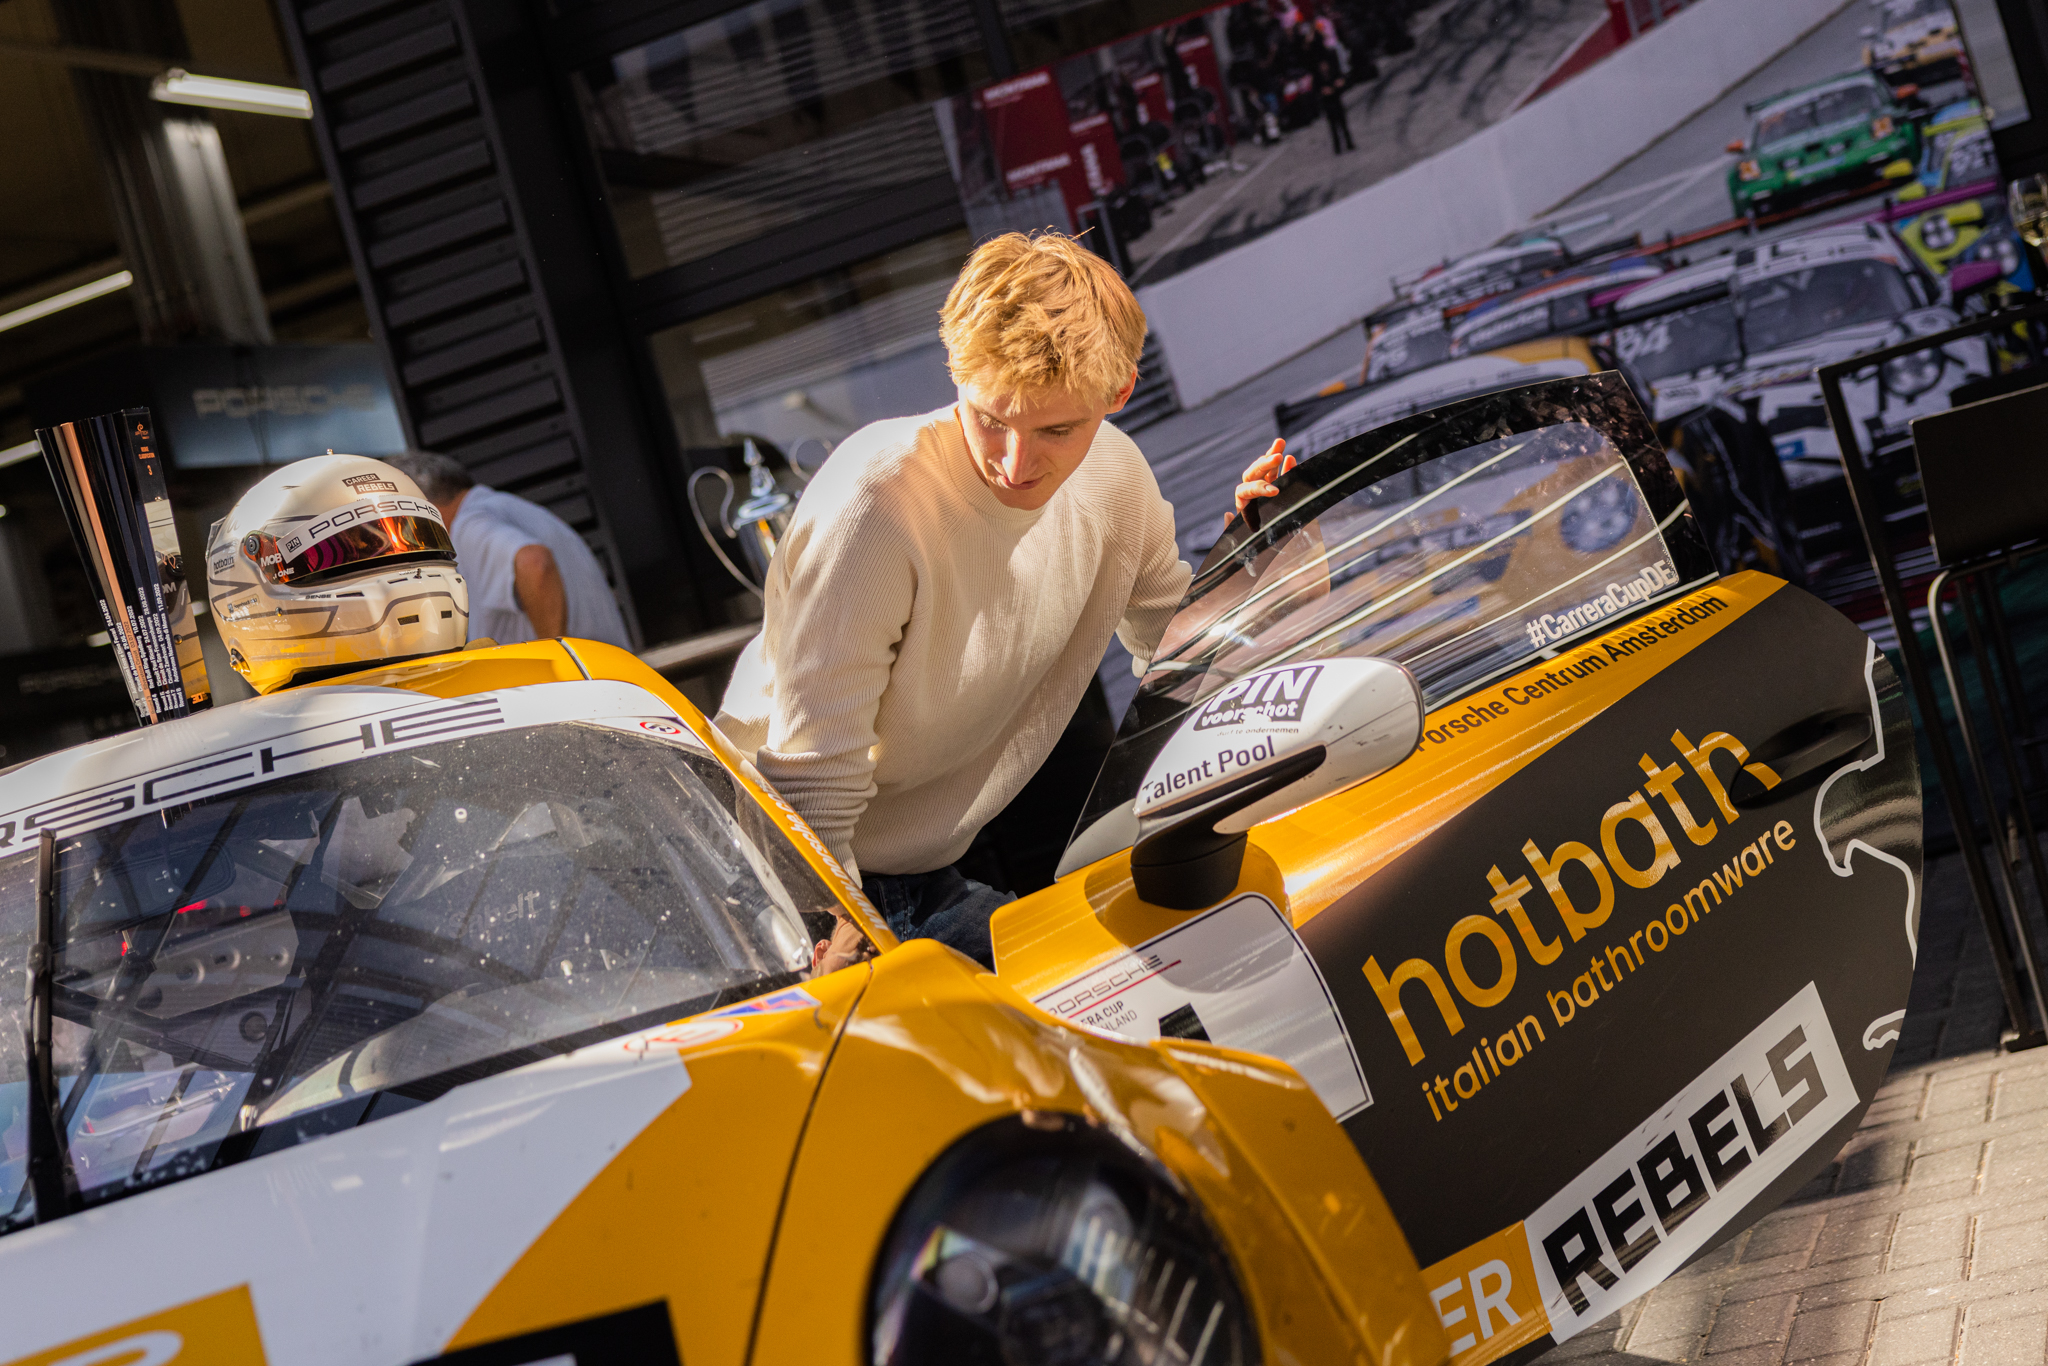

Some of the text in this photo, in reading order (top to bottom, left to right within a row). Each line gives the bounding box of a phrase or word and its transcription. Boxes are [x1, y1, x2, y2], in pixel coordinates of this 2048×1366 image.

[346, 474, 378, 485] CAREER
[357, 483, 396, 492] REBELS
[308, 500, 442, 539] PORSCHE
[287, 538, 301, 549] PIN
[138, 587, 150, 615] 28.08.2022
[154, 583, 164, 611] 11.09.2022
[1526, 560, 1677, 649] #CarreraCupDE
[100, 599, 113, 627] 24.04.2022
[127, 605, 139, 634] 10.07.2022
[123, 621, 135, 648] 03.07.2022
[138, 615, 150, 643] 24.07.2022
[153, 613, 164, 642] 04.09.2022
[132, 650, 141, 665] Circuit
[135, 635, 146, 658] Spielberg
[147, 645, 155, 660] Ricard
[160, 643, 170, 668] Zandvoort
[165, 634, 174, 656] Nazionale
[1503, 655, 1609, 706] Centrum
[1602, 595, 1729, 662] Amsterdam
[126, 651, 136, 670] Monaco
[170, 656, 179, 683] Autodromo
[137, 666, 148, 690] Silverstone
[154, 671, 162, 687] Circuit
[160, 669, 168, 685] Circuit
[1207, 667, 1317, 712] PIN
[153, 698, 161, 713] Round
[160, 696, 169, 711] Round
[166, 694, 174, 710] Round
[171, 693, 179, 709] Round
[0, 698, 504, 848] SCHE
[1142, 736, 1275, 803] Talent Pool
[1362, 729, 1782, 1066] hotbath
[1422, 820, 1797, 1122] italian bathroomware
[1103, 1000, 1124, 1017] CUP
[1542, 1024, 1828, 1317] REBELS
